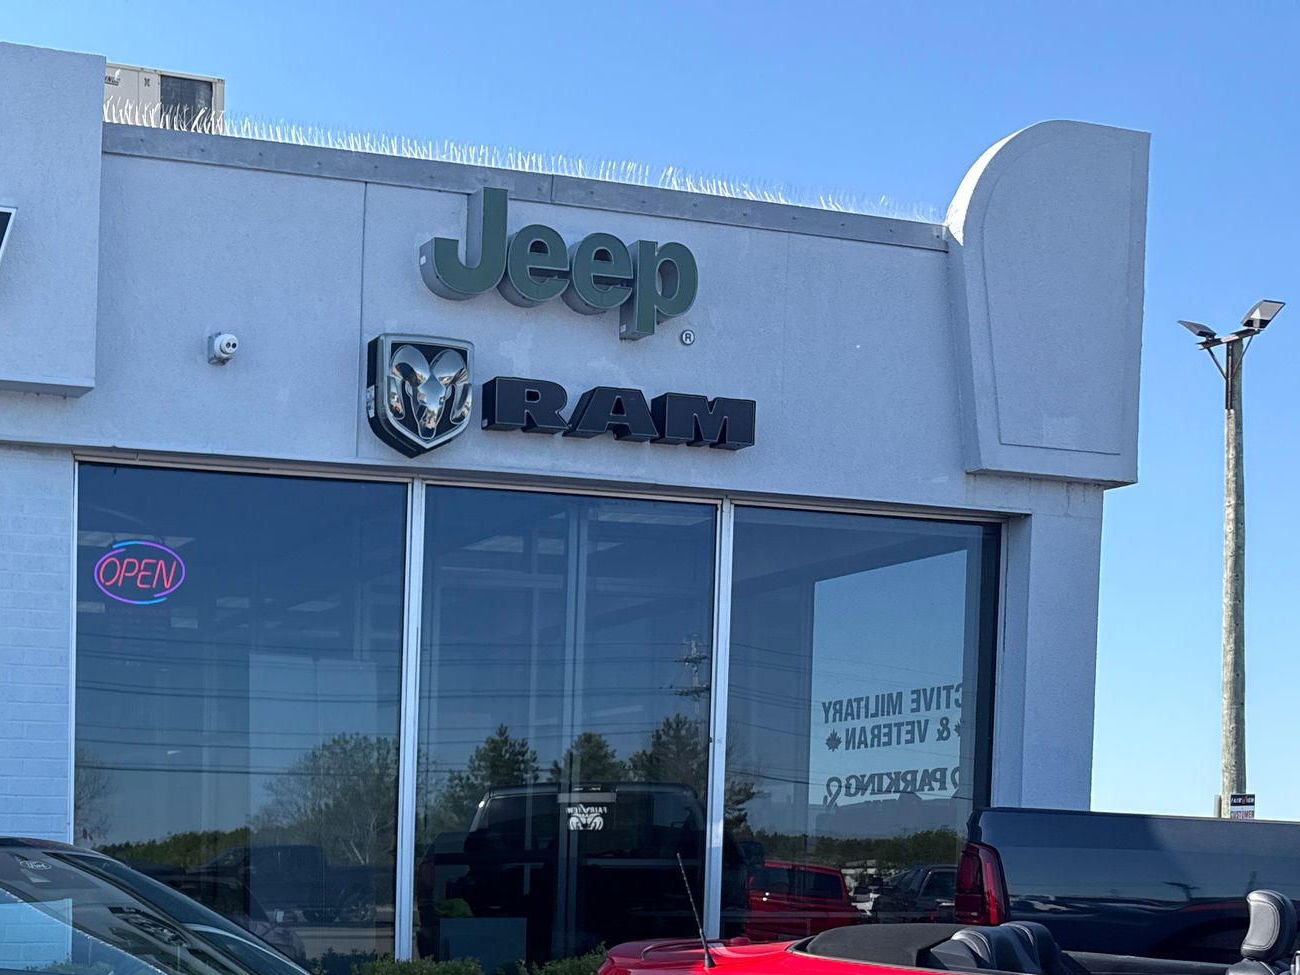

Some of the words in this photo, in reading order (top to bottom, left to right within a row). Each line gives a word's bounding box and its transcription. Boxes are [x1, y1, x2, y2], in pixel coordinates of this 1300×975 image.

[420, 187, 698, 340] Jeep
[482, 376, 757, 450] RAM
[99, 557, 177, 589] OPEN
